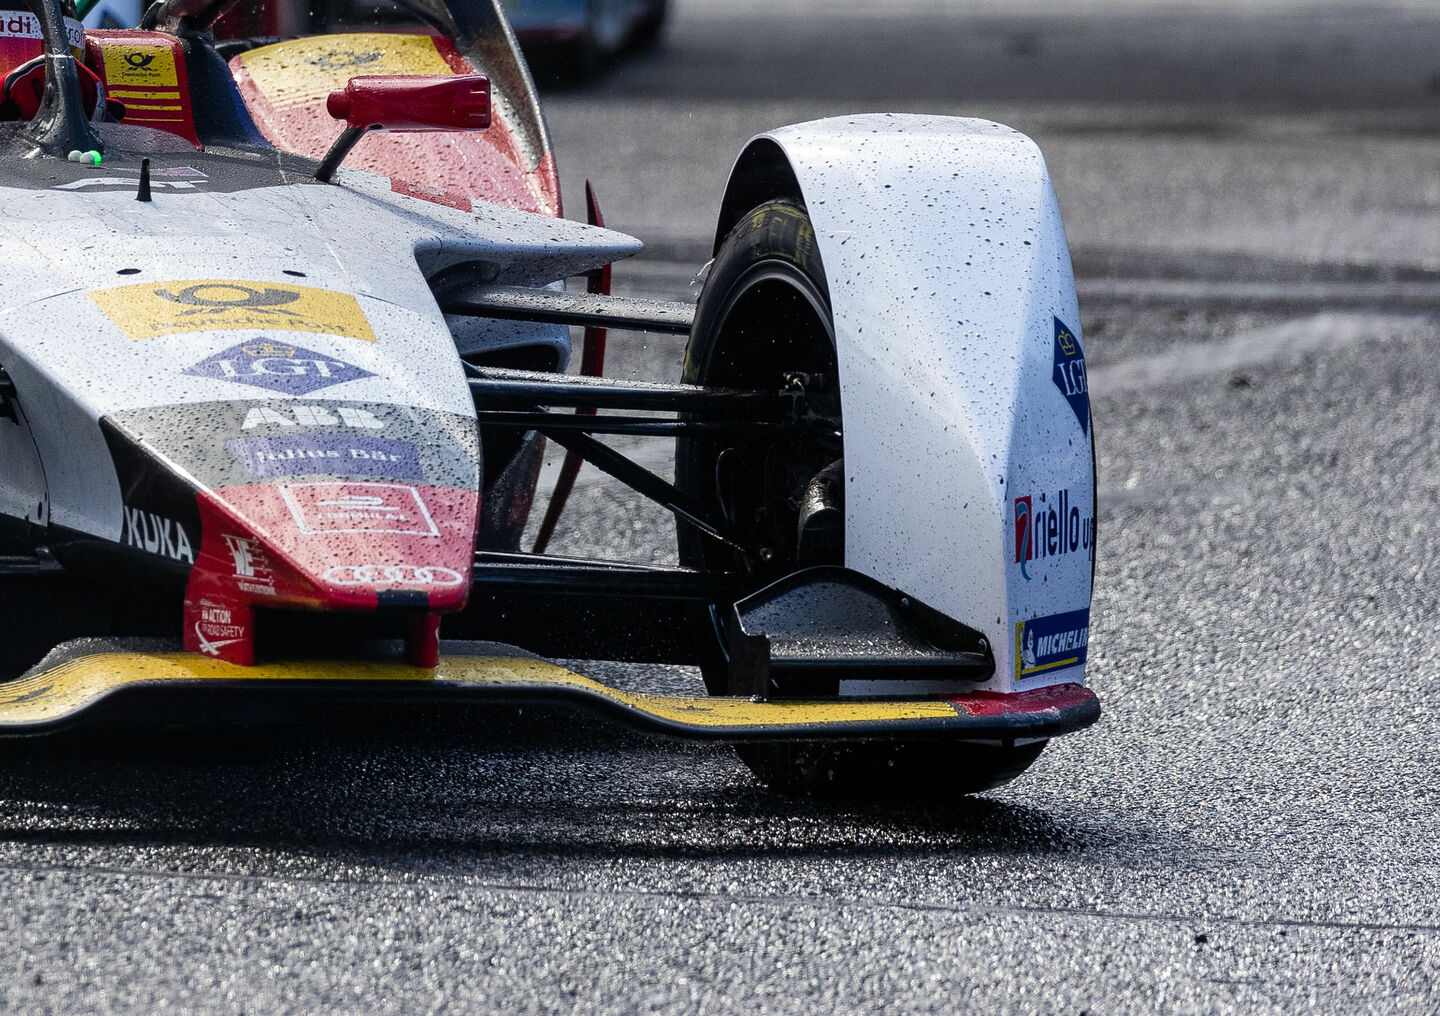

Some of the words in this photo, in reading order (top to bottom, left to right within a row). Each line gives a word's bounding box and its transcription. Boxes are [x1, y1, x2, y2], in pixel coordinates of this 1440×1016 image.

[288, 319, 345, 333] Post
[217, 358, 345, 378] LGT
[241, 405, 384, 430] ABB
[256, 448, 340, 464] Julius
[350, 448, 401, 463] Bär
[1034, 489, 1080, 560] riello
[124, 505, 195, 565] KUKA
[220, 625, 245, 637] SAFETY
